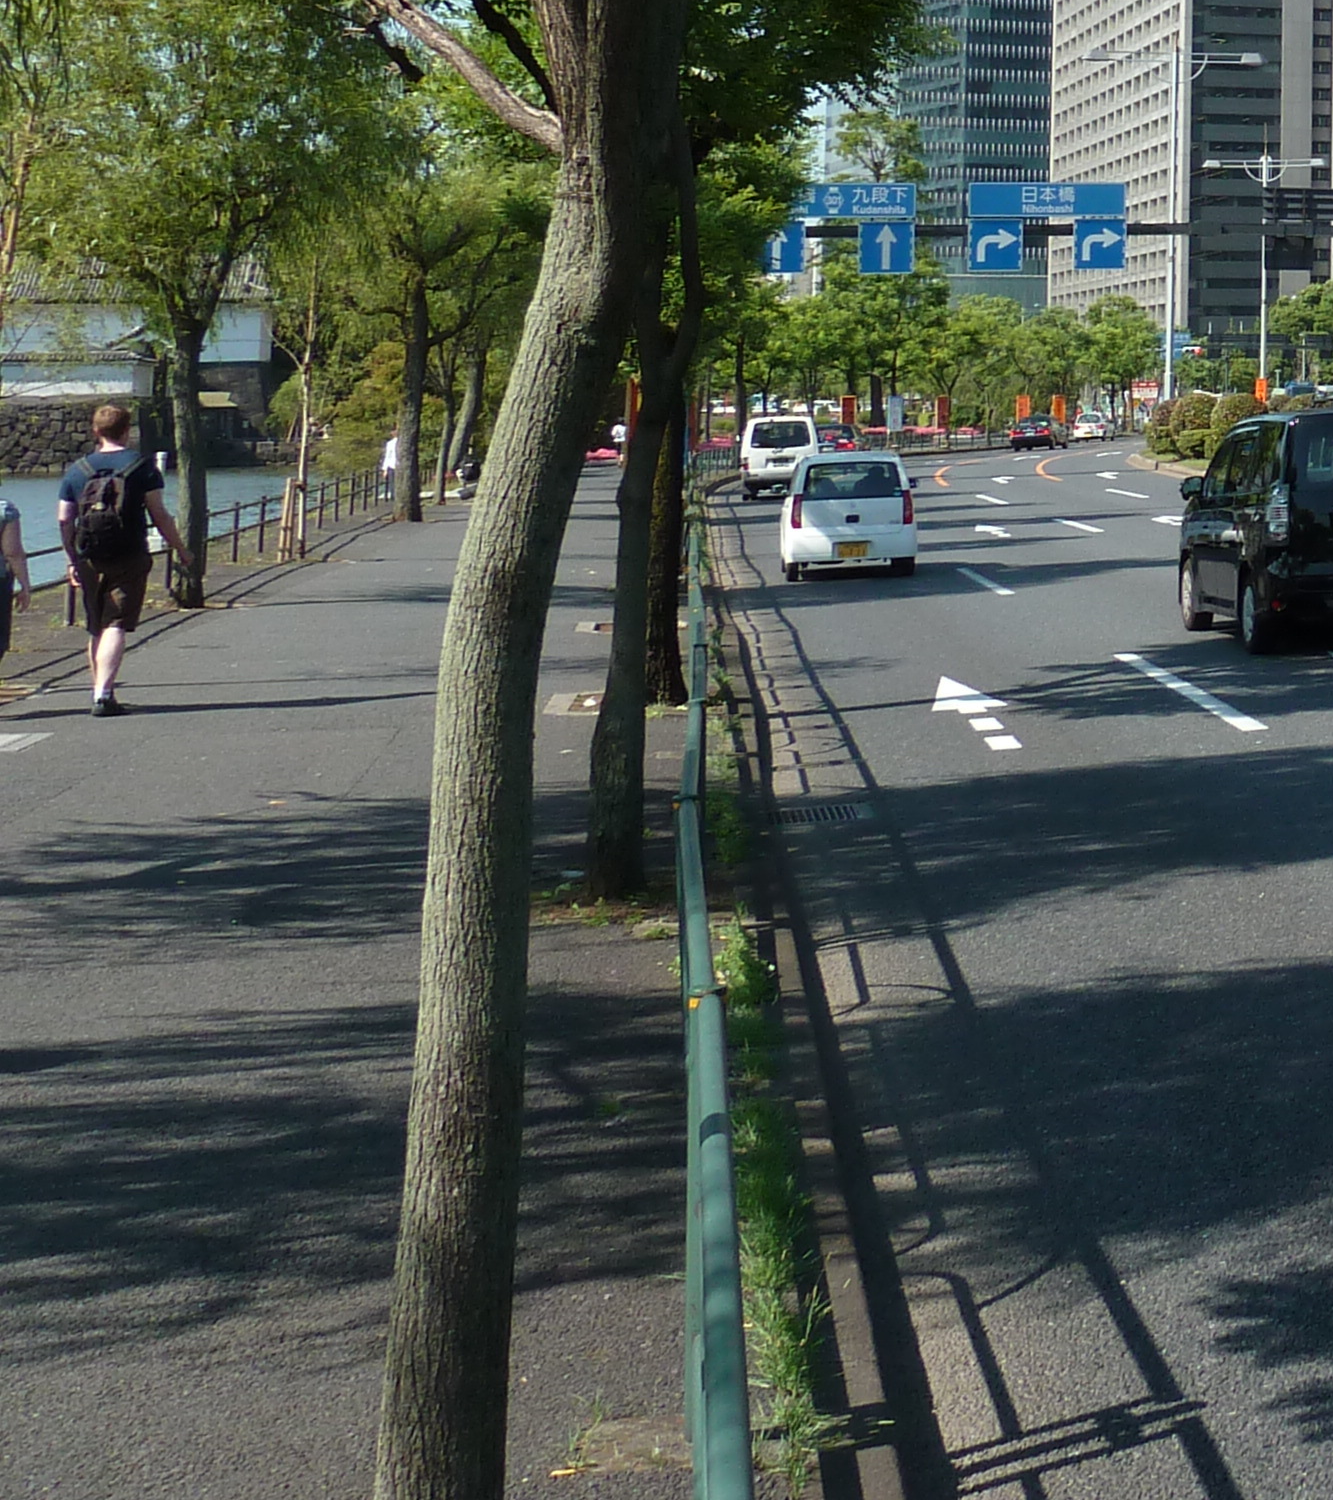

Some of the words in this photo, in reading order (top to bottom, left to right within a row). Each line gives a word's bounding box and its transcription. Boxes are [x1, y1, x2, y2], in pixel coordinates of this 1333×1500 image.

[852, 186, 908, 203] 九段下
[1022, 186, 1075, 203] 日本橋
[852, 205, 906, 214] Kudanshita
[1022, 204, 1074, 213] Nihonbashi
